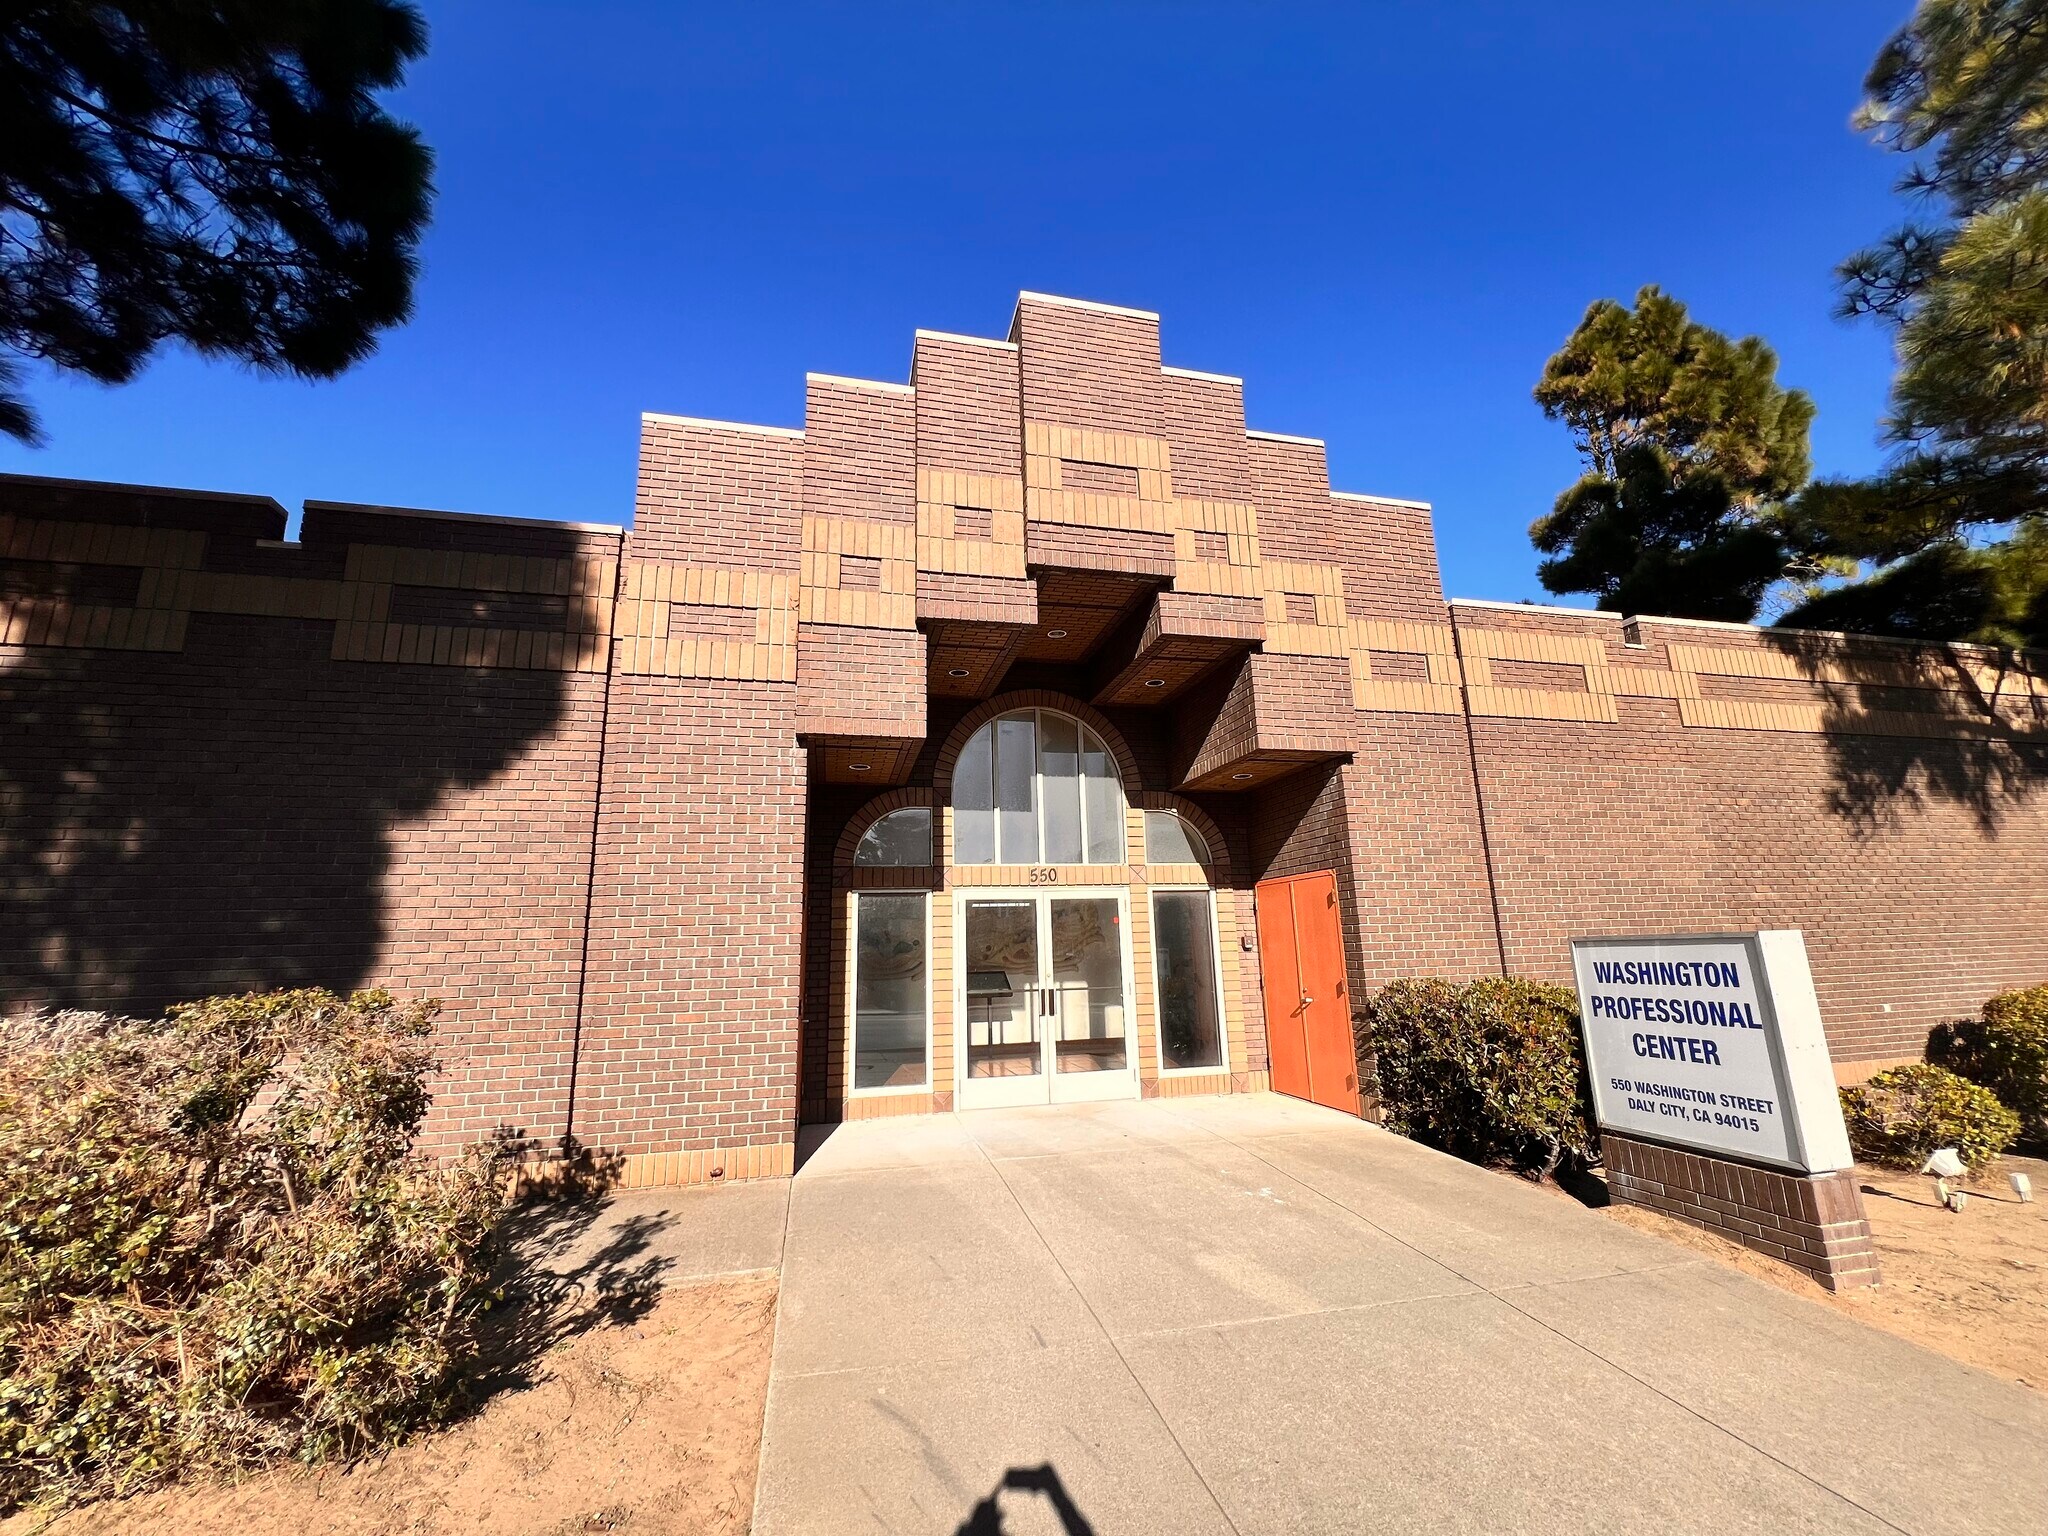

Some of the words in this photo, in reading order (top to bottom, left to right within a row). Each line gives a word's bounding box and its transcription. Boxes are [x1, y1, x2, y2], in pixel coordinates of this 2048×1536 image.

[1030, 868, 1057, 883] 550
[1593, 962, 1740, 987] WASHINGTON
[1591, 996, 1762, 1029] PROFESSIONAL
[1633, 1033, 1721, 1065] CENTER
[1611, 1078, 1631, 1092] 550
[1634, 1081, 1716, 1105] WASHINGTON
[1720, 1094, 1773, 1114] STREET
[1627, 1097, 1656, 1113] DALY
[1660, 1105, 1690, 1122] CITY,
[1693, 1109, 1711, 1123] CA
[1715, 1113, 1759, 1132] 94015
